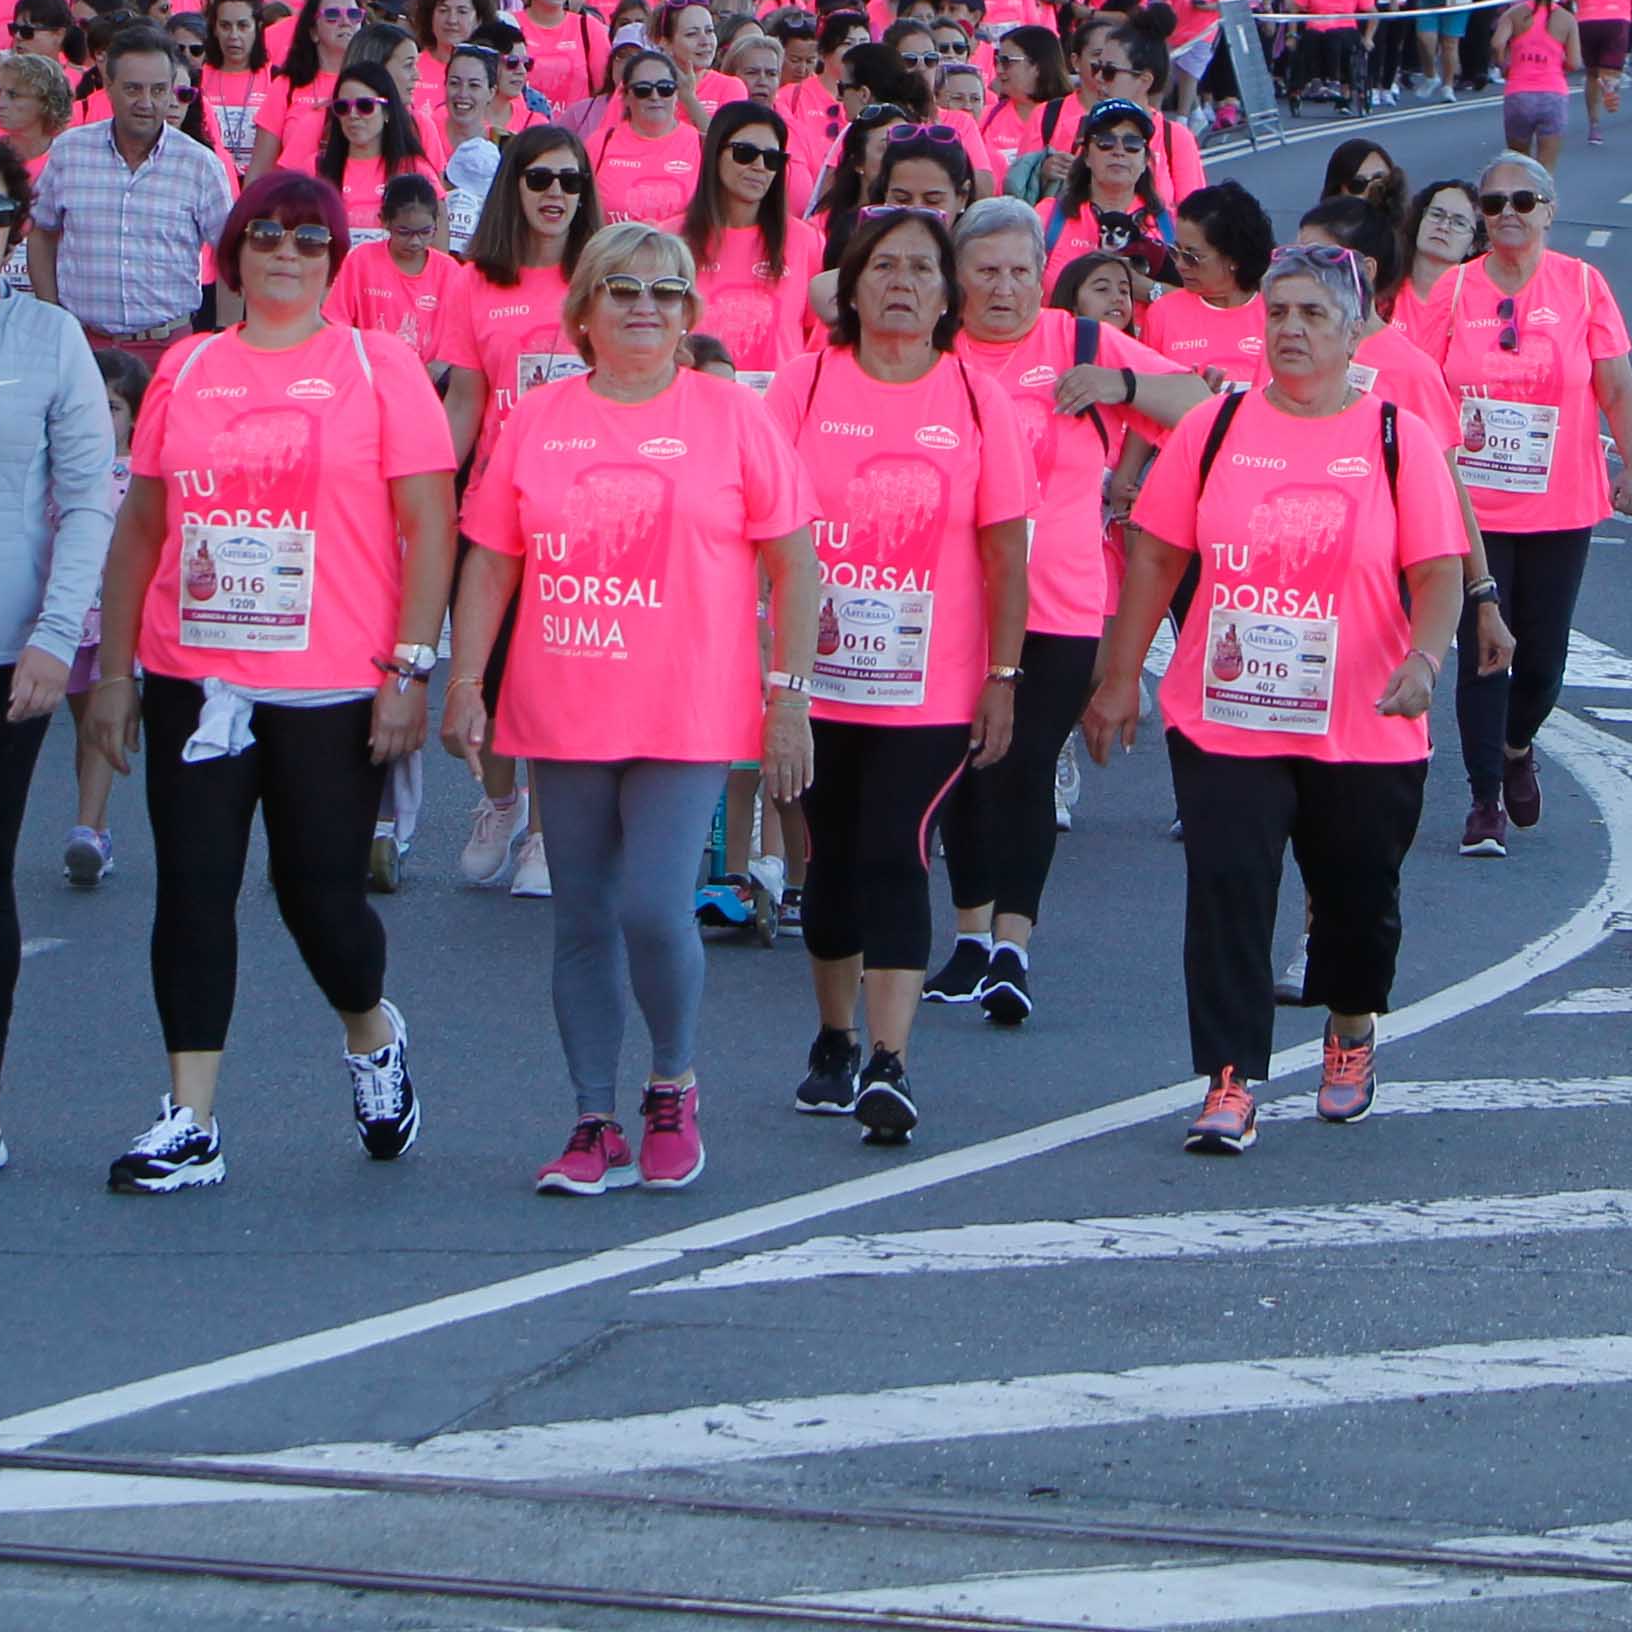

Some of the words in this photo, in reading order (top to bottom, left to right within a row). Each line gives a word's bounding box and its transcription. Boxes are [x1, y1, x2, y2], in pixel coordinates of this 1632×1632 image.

[448, 212, 472, 224] 016
[488, 304, 530, 319] OYSHO
[819, 420, 874, 438] OYSHO
[1488, 435, 1521, 450] 016
[1232, 453, 1287, 471] OYSHO
[174, 469, 216, 498] TU
[813, 520, 849, 549] TU
[532, 533, 567, 561] TU
[1211, 543, 1249, 572] TU
[220, 574, 266, 594] 016
[538, 573, 663, 609] DORSAL
[229, 597, 257, 610] 1209
[1213, 583, 1339, 620] DORSAL
[542, 614, 626, 648] SUMA
[843, 633, 887, 652] 016
[850, 655, 878, 667] 1600
[1247, 659, 1289, 679] 016
[1255, 681, 1277, 694] 402
